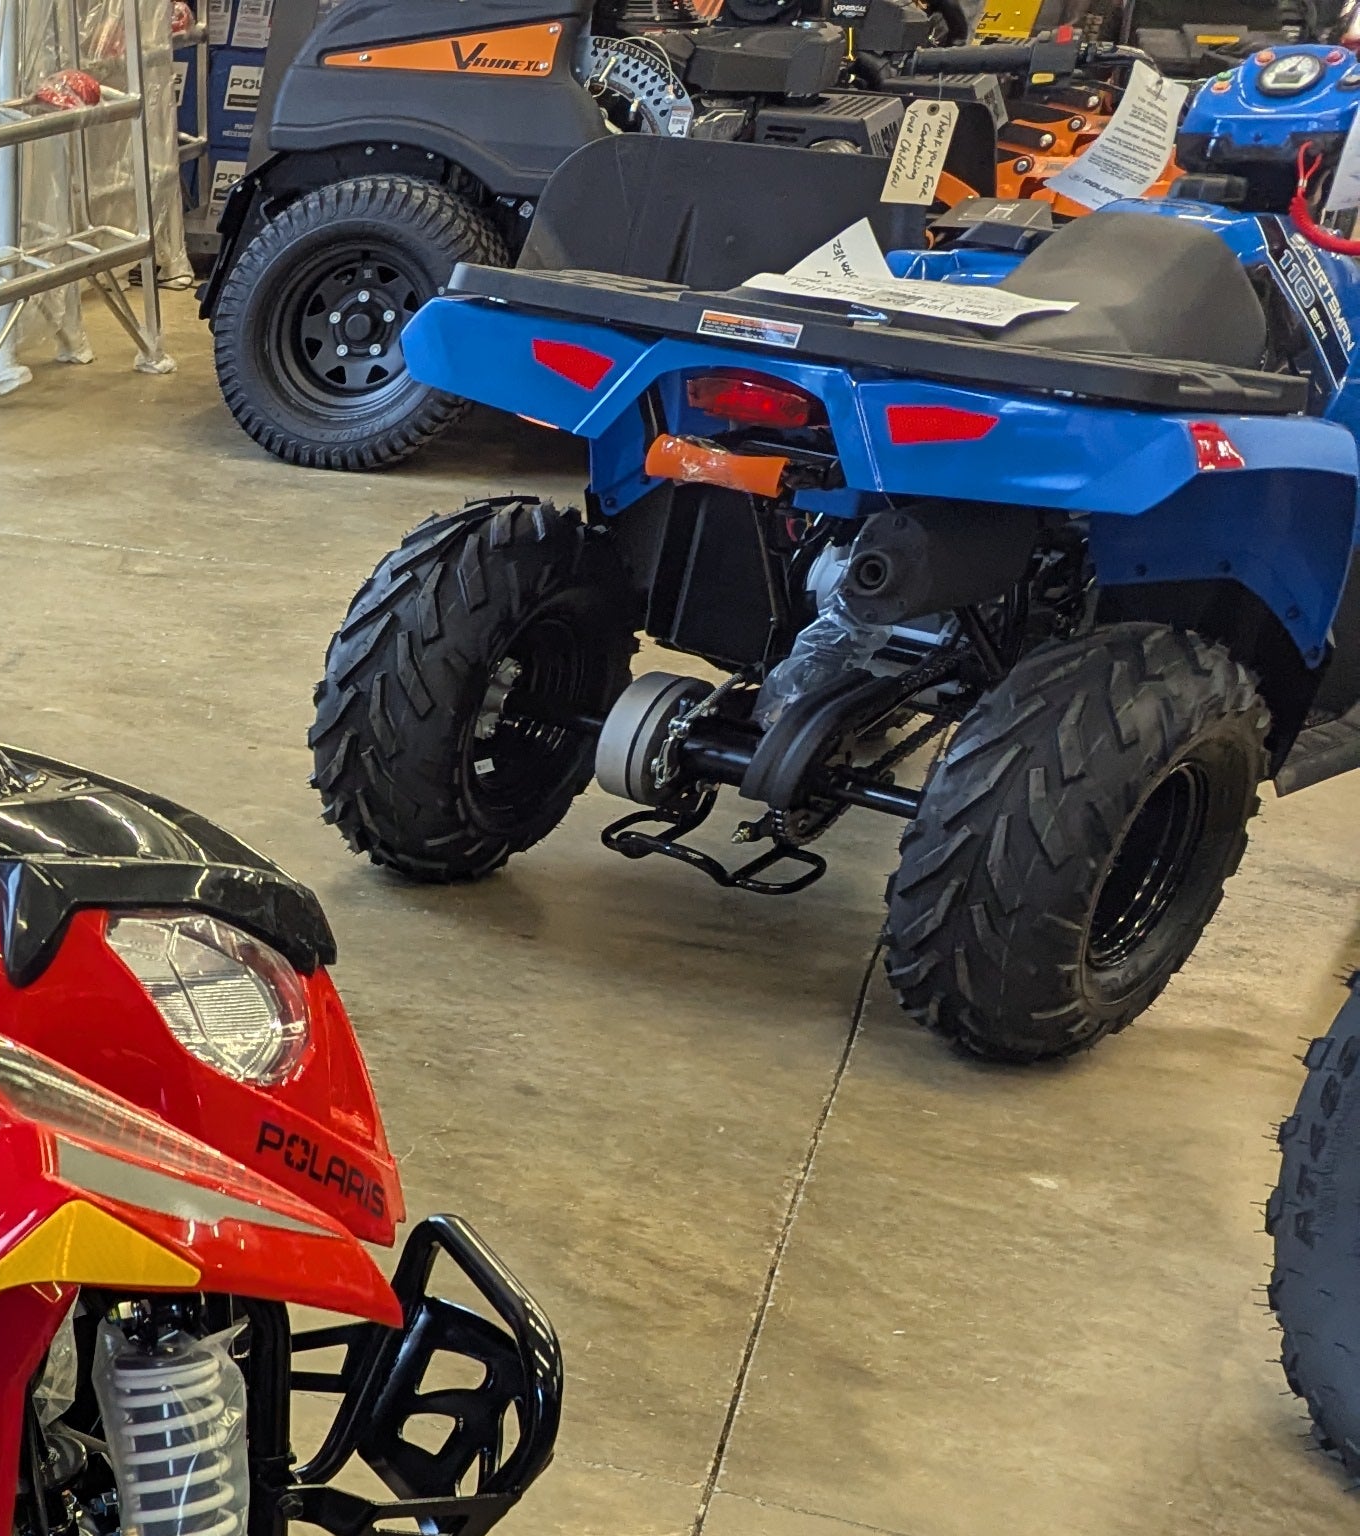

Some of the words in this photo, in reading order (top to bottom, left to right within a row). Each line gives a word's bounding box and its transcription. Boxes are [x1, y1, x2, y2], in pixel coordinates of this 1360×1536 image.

[1279, 249, 1316, 309] 110
[1309, 306, 1328, 340] EFI
[1290, 232, 1356, 352] SPORTSMAN
[255, 1120, 385, 1218] POLARIS
